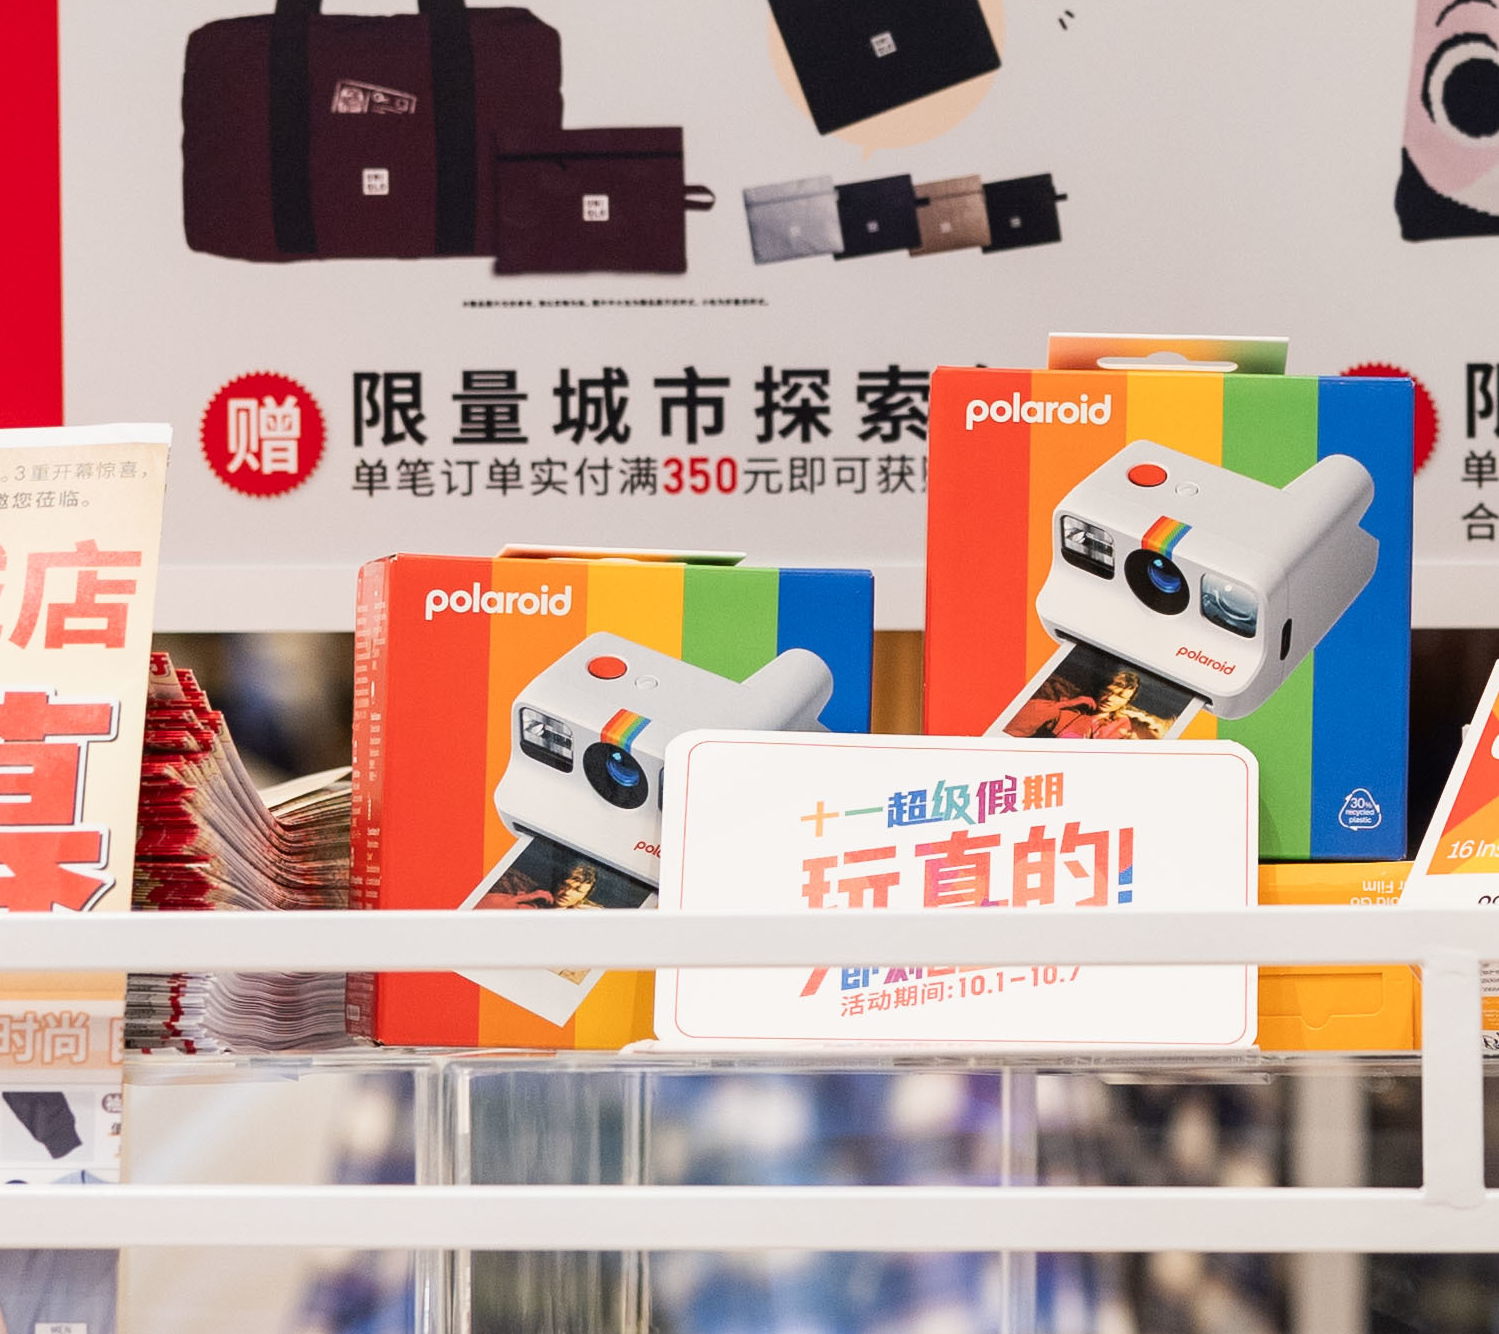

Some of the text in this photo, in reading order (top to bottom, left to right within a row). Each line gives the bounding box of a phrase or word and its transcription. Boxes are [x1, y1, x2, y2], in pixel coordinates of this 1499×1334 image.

[352, 363, 929, 446] 限量城市探索
[966, 394, 1112, 430] polaroid
[225, 397, 302, 476] 赠
[351, 453, 929, 500] 单笔订单实付满350元即可获
[425, 582, 573, 621] polaroid
[1175, 646, 1237, 675] polaroid
[800, 772, 1064, 838] 十一超级假期
[1350, 797, 1373, 809] 30%
[800, 821, 1134, 909] 玩真的!
[1446, 840, 1475, 858] 16
